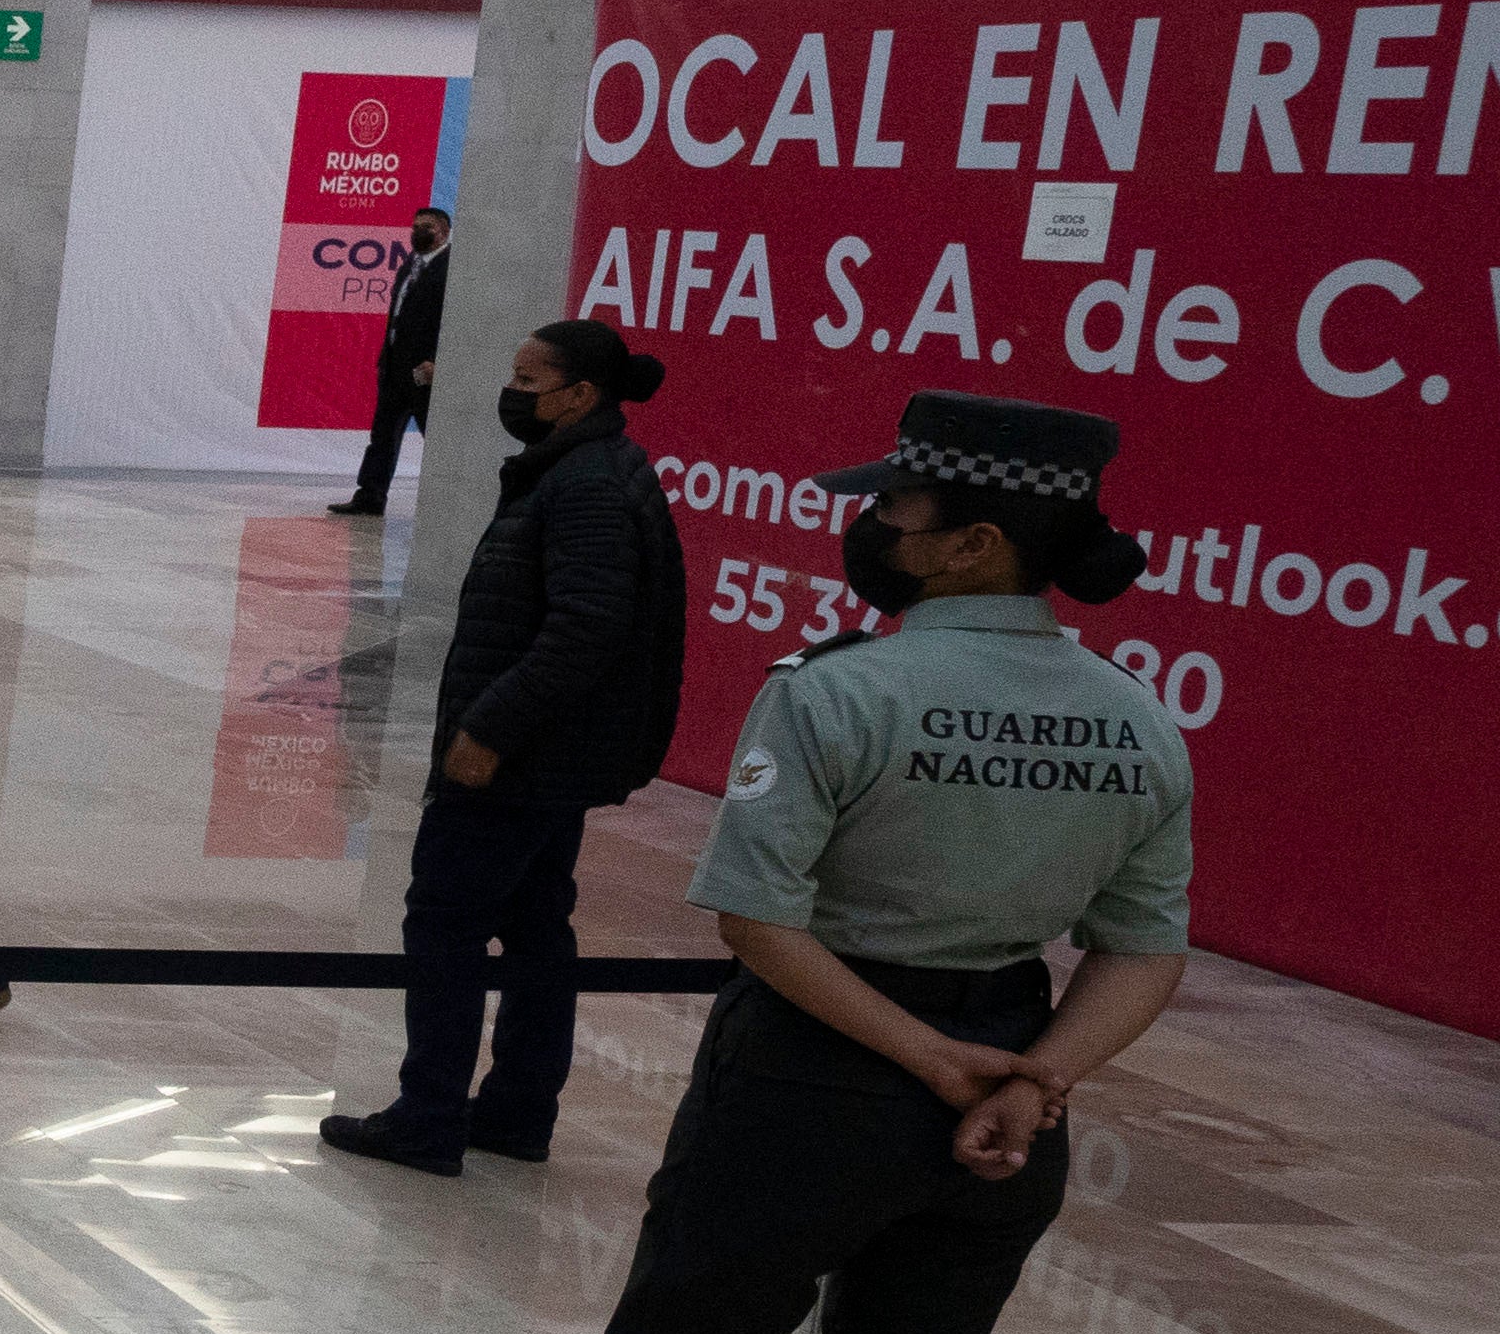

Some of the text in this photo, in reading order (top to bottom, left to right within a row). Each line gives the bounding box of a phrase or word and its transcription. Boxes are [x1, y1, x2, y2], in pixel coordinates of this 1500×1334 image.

[576, 29, 905, 168] OCAL
[956, 17, 1162, 172] EN
[327, 151, 399, 172] RUMBO
[320, 172, 399, 196] MÉXICO
[339, 197, 376, 209] CDMX
[1045, 227, 1089, 237] CALZADO
[1052, 215, 1086, 224] CROCS
[342, 277, 392, 303] PR
[578, 226, 1500, 406] AIFA S.A. de C.
[709, 557, 788, 633] 55
[921, 707, 1143, 751] GUARDIA
[905, 750, 1148, 796] NACIONAL
